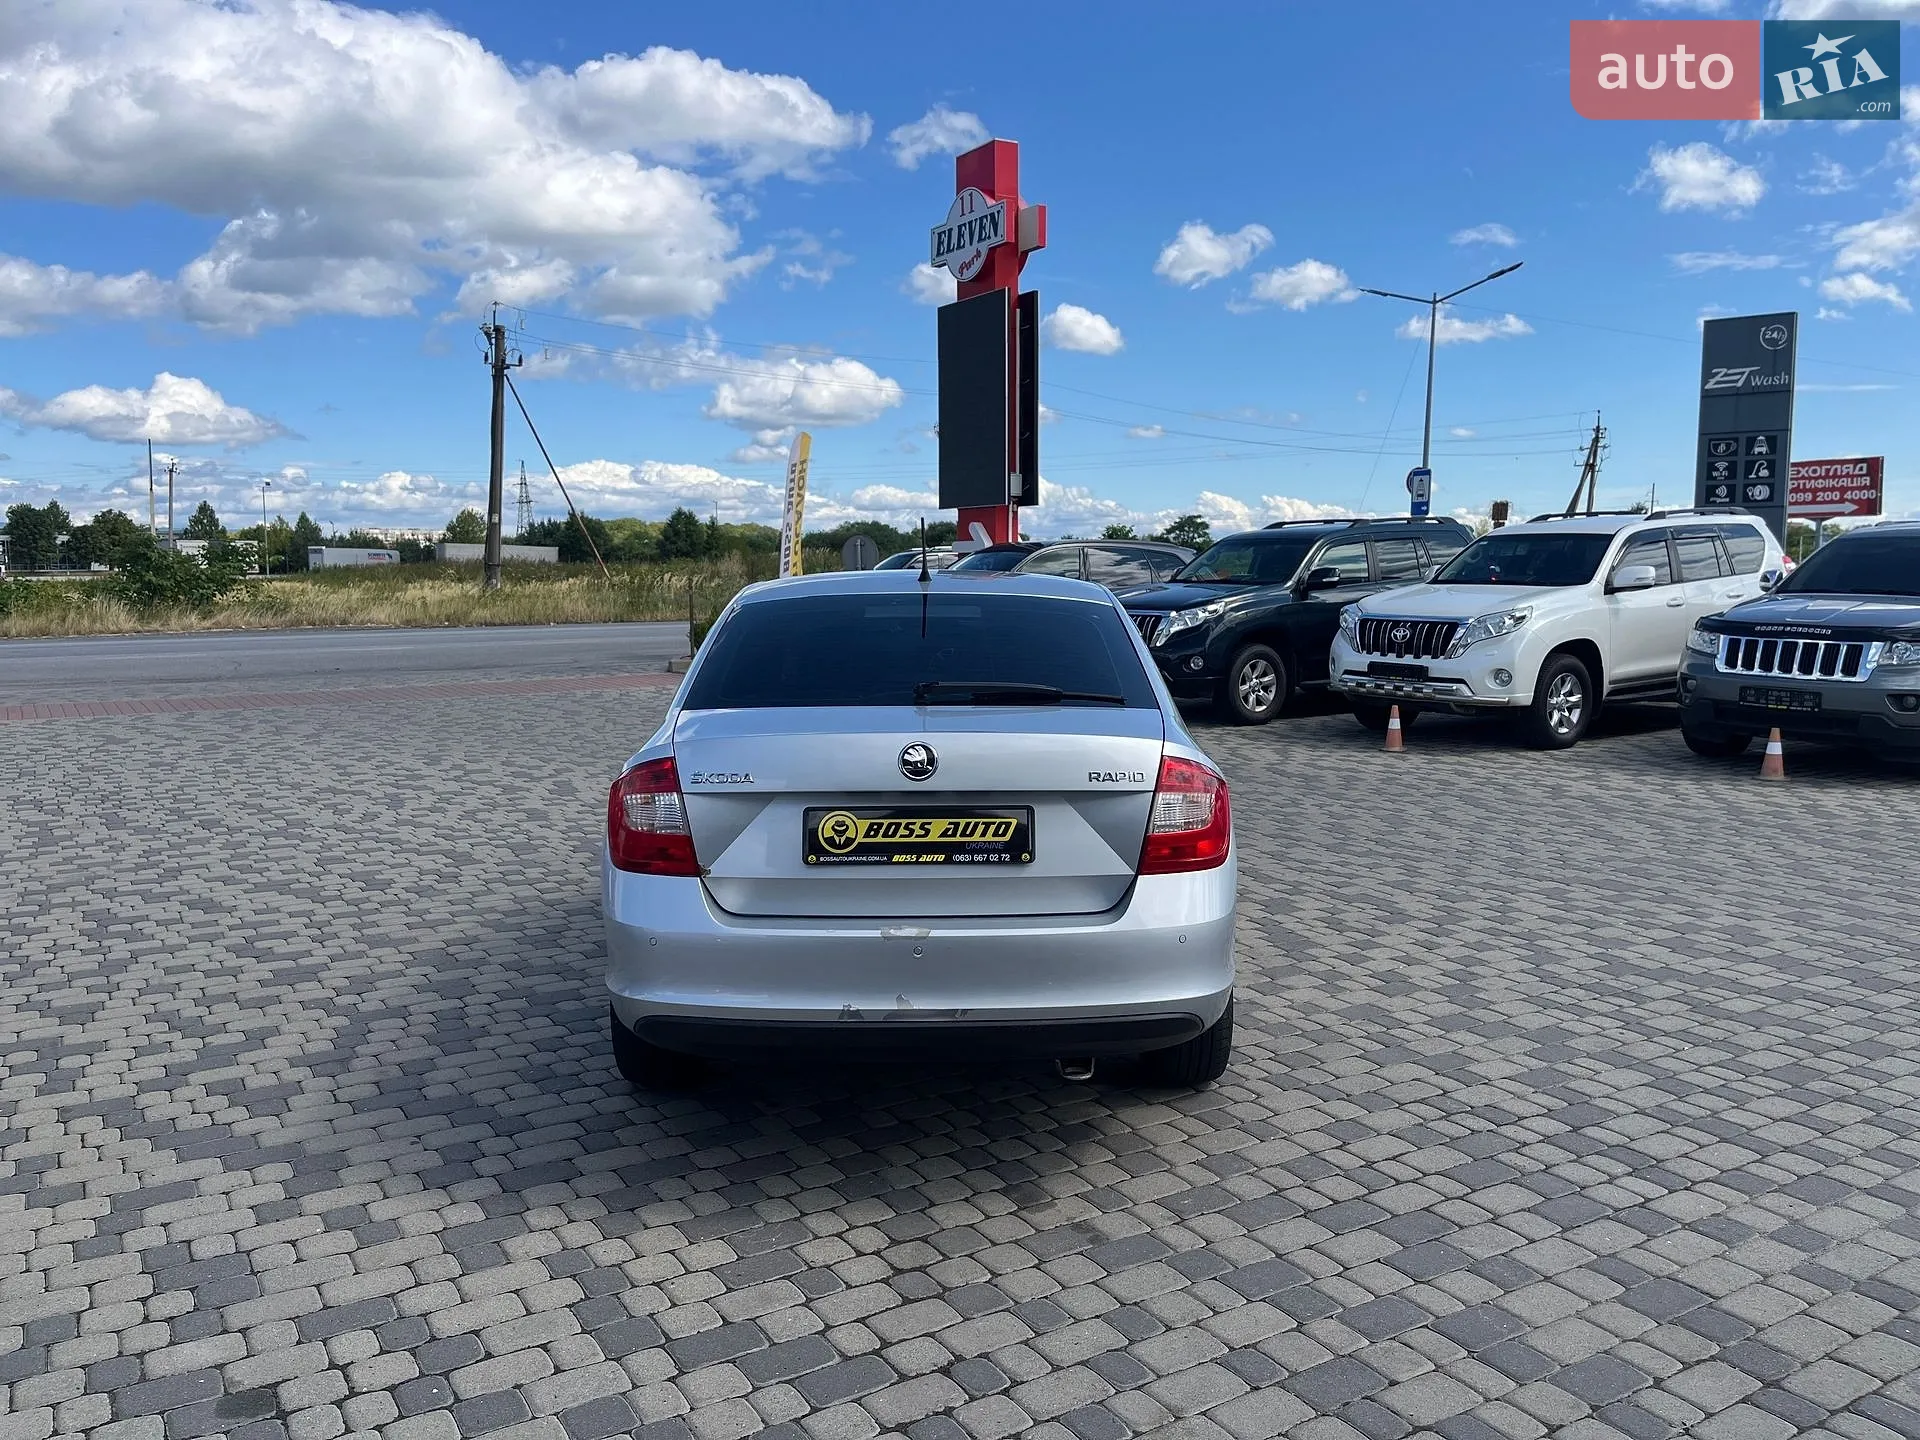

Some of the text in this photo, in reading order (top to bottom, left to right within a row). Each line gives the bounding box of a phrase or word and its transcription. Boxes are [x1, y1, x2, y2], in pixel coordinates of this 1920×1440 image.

[960, 191, 975, 217] 11
[935, 210, 1001, 258] ELEVEN
[958, 247, 982, 277] Park
[1750, 371, 1789, 387] Wash
[1789, 489, 1877, 502] 099 200 4000
[1088, 771, 1146, 783] RAPID
[862, 821, 1013, 839] BOSS AUTO
[965, 842, 1005, 850] UKRAINE
[891, 854, 945, 862] BOSS AUTO
[952, 854, 1010, 862] (063) 667 02 72
